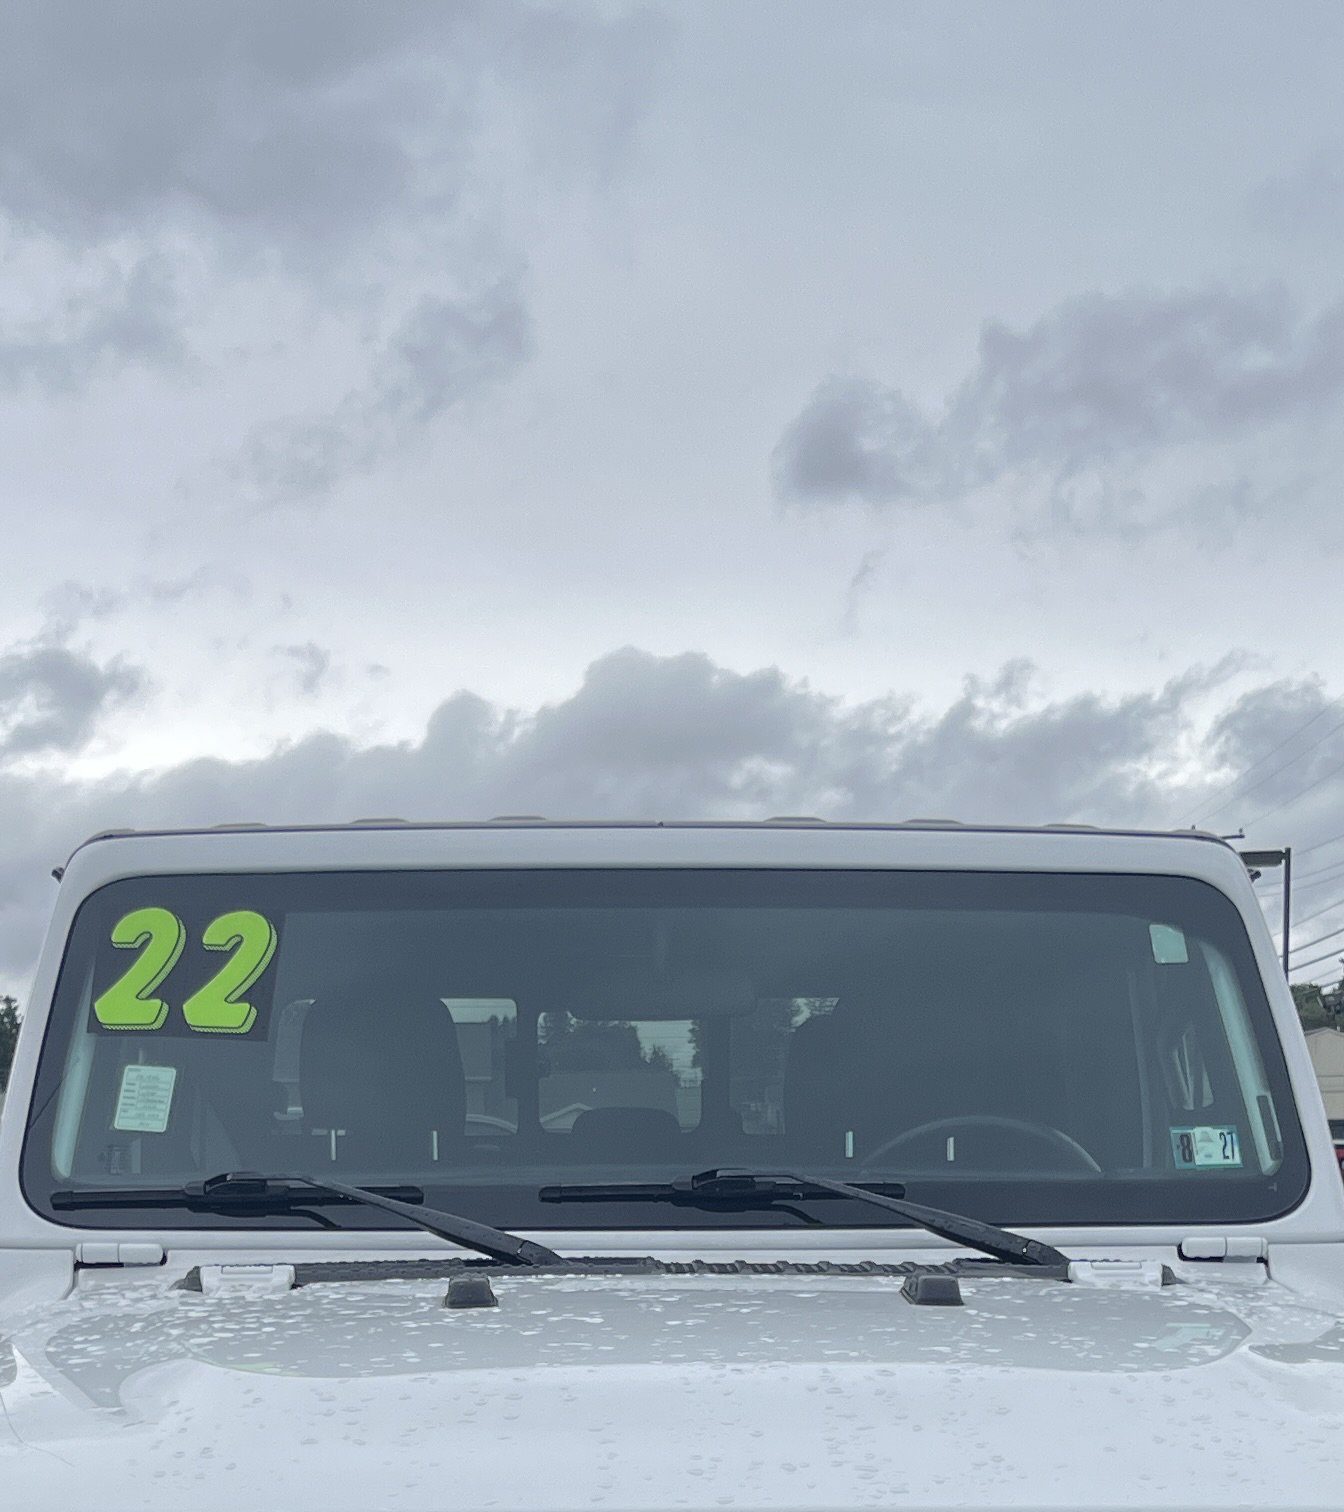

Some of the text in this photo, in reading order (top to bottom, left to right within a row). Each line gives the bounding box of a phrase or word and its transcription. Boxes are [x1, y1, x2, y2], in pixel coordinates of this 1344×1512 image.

[94, 907, 278, 1034] 22
[1180, 1131, 1235, 1163] 8 27
